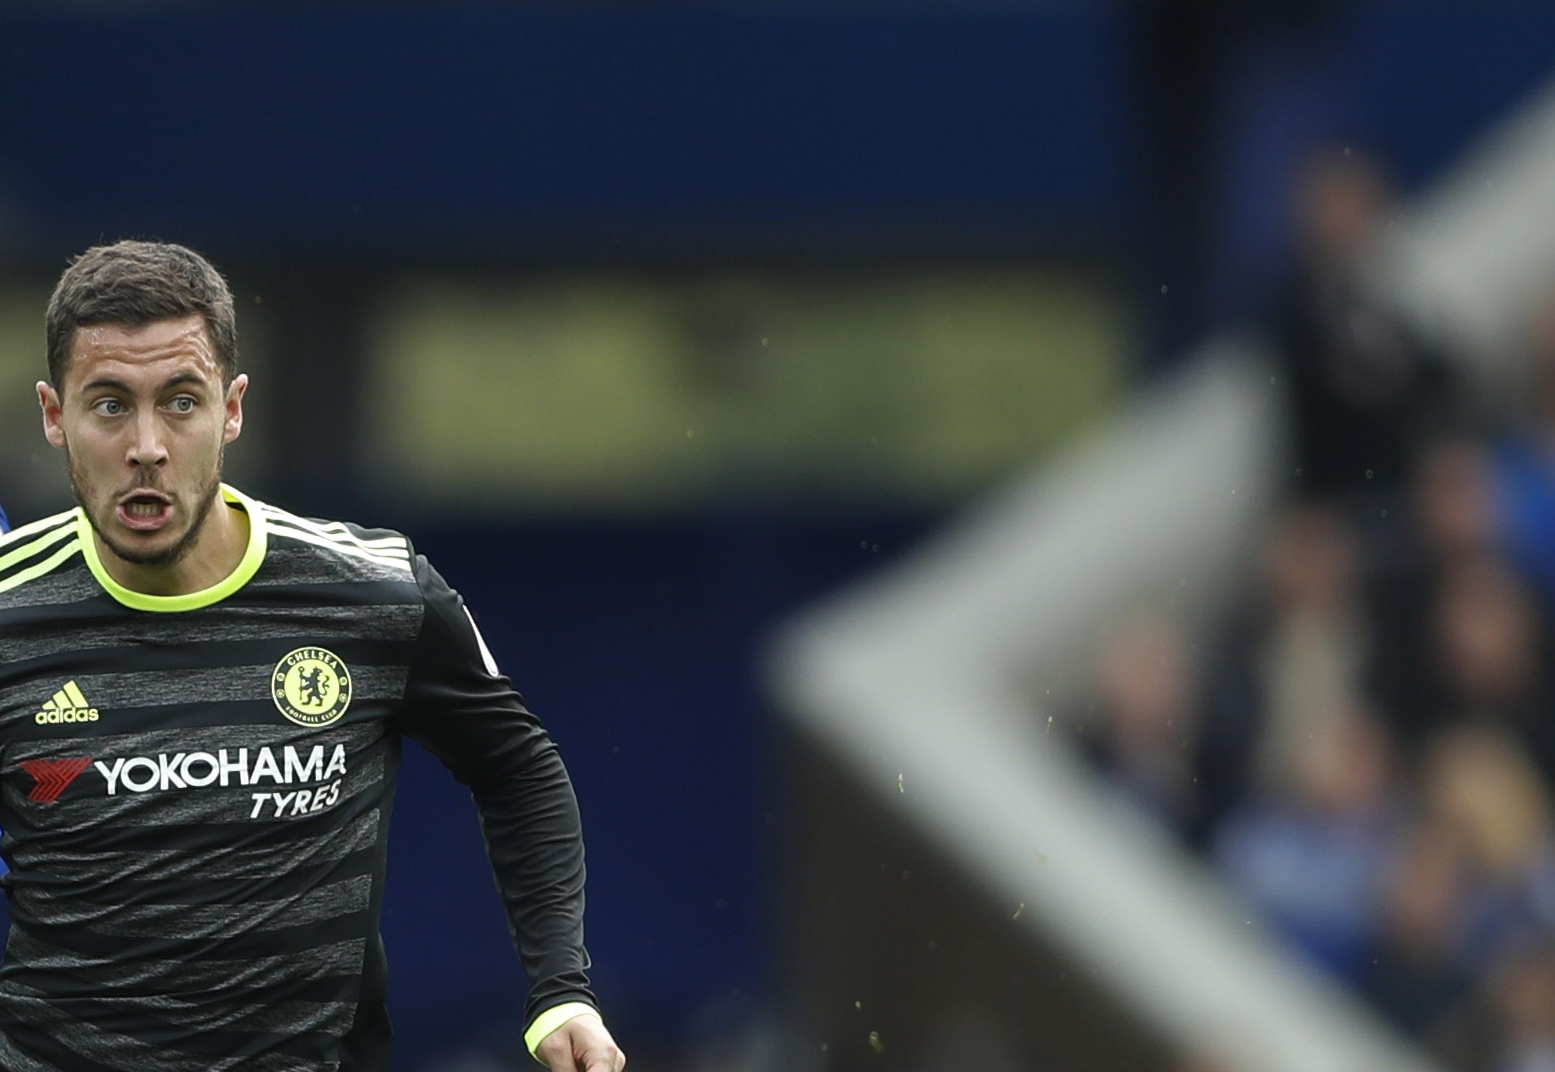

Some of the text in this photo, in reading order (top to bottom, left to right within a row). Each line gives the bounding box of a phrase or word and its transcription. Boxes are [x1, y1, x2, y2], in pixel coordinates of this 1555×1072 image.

[287, 650, 338, 669] CHELSEA
[35, 706, 100, 725] adidas
[94, 743, 347, 795] YOKOHAMA
[249, 779, 342, 819] TYRES
